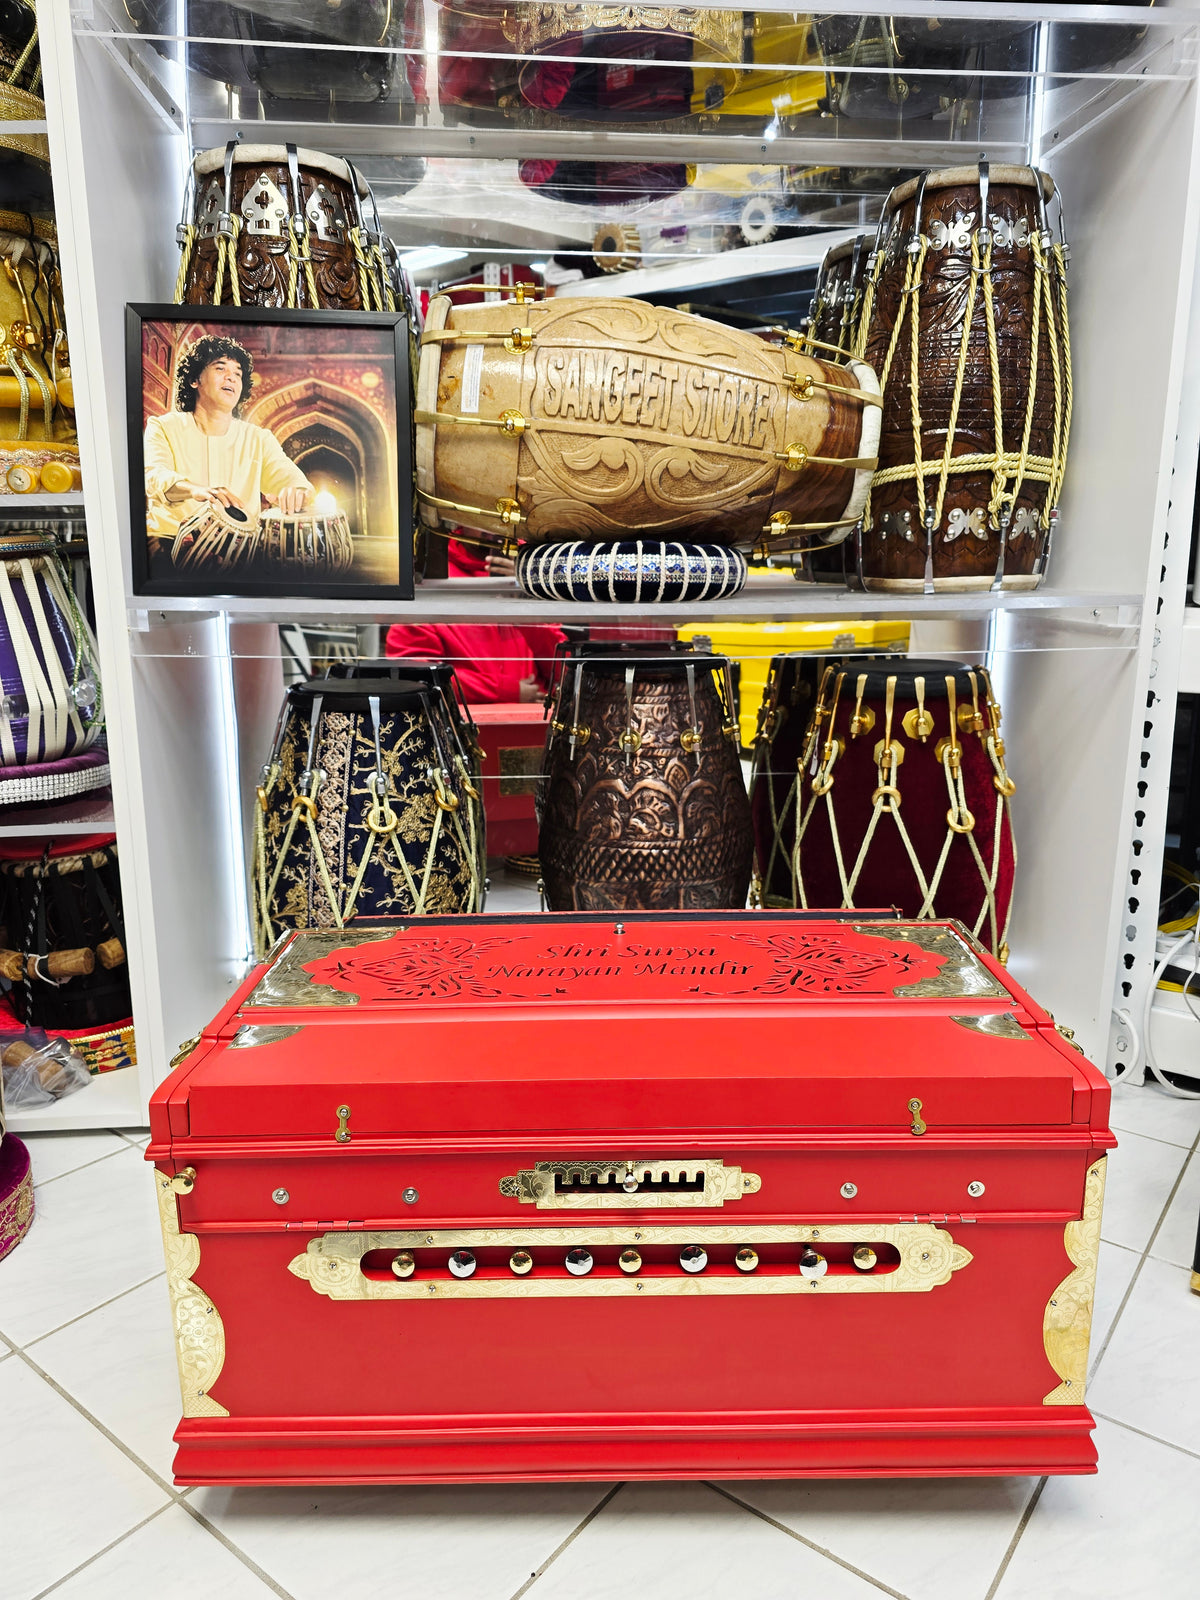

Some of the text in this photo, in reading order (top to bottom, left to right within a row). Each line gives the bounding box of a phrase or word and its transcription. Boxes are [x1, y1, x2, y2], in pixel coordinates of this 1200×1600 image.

[543, 350, 679, 430] SANGEET
[683, 370, 772, 449] STORE
[538, 943, 718, 960] Shri Surya
[485, 960, 754, 981] Narayan Mandir
